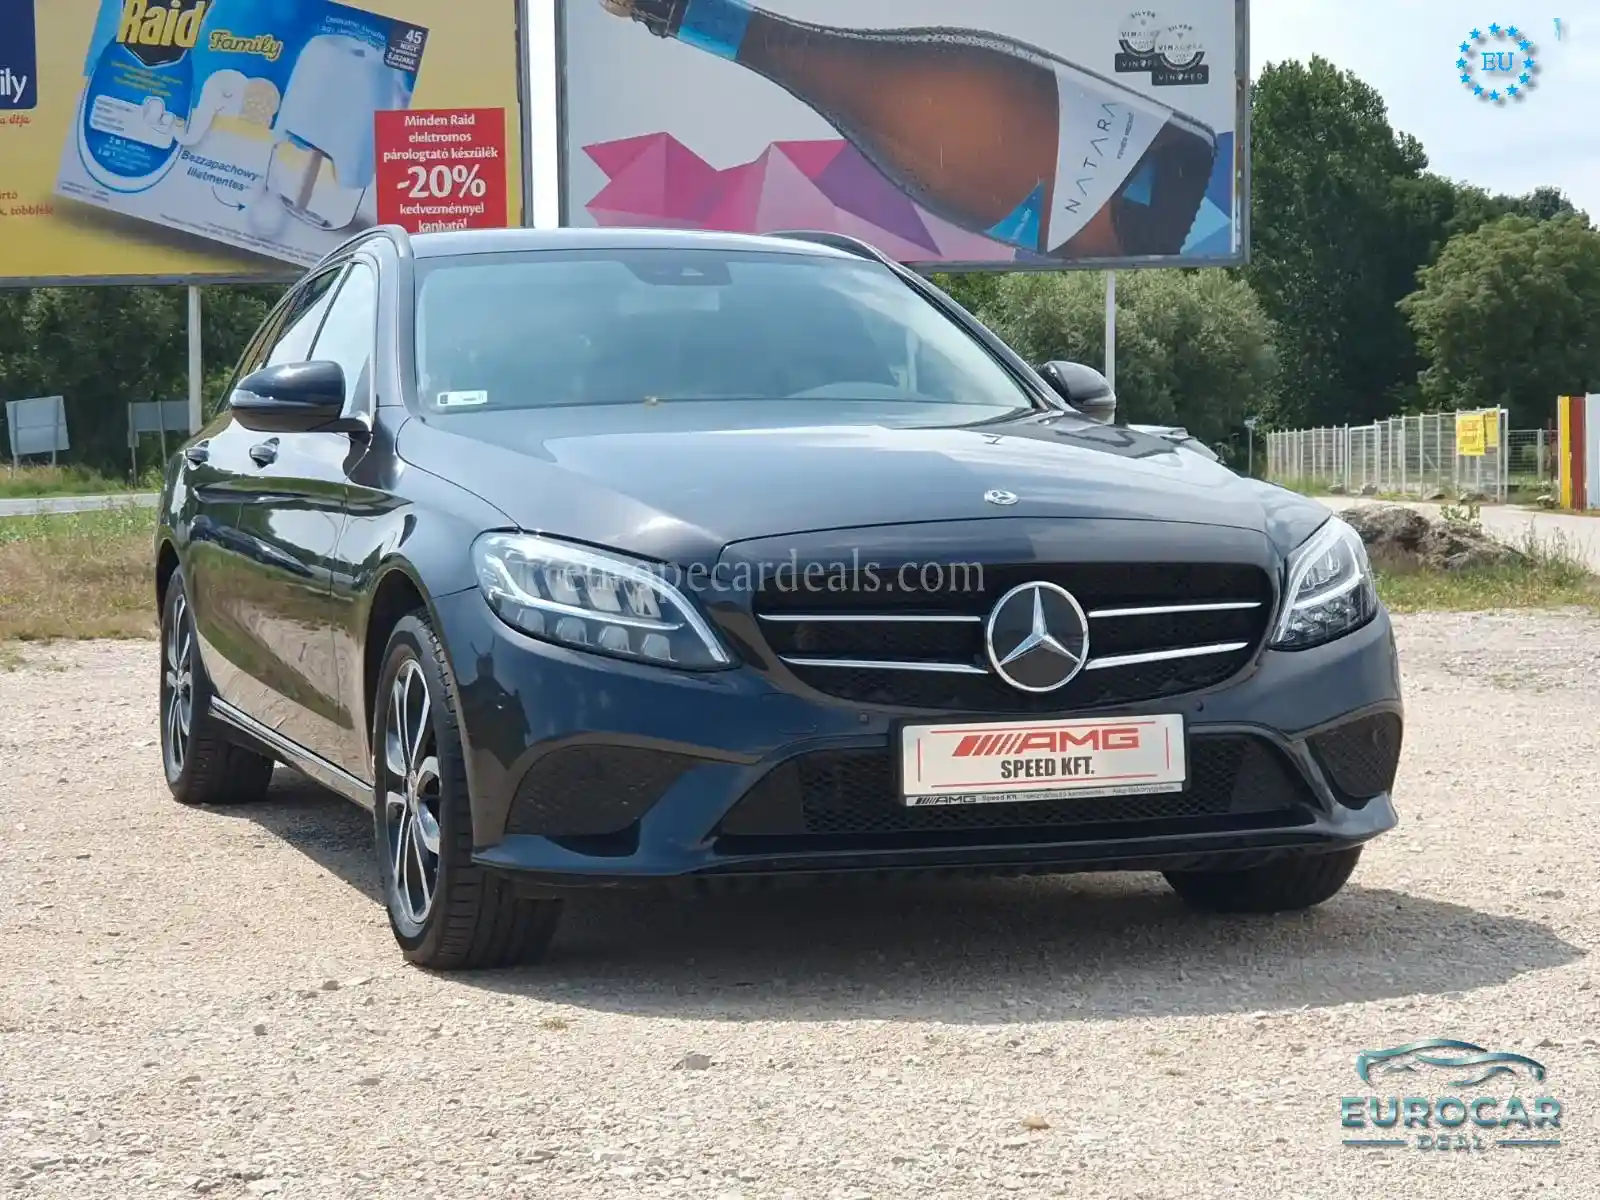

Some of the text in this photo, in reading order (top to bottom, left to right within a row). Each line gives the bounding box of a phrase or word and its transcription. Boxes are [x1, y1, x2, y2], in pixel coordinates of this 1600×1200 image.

[116, 0, 203, 48] Raid
[404, 29, 423, 45] 45
[209, 31, 284, 61] Family
[404, 114, 475, 126] Minden Raid
[408, 132, 472, 143] elektromos
[383, 147, 498, 162] párologtató készülék
[396, 164, 486, 198] -20%
[400, 202, 485, 216] kedvezménnyel
[1000, 756, 1096, 779] SPEED KFT.
